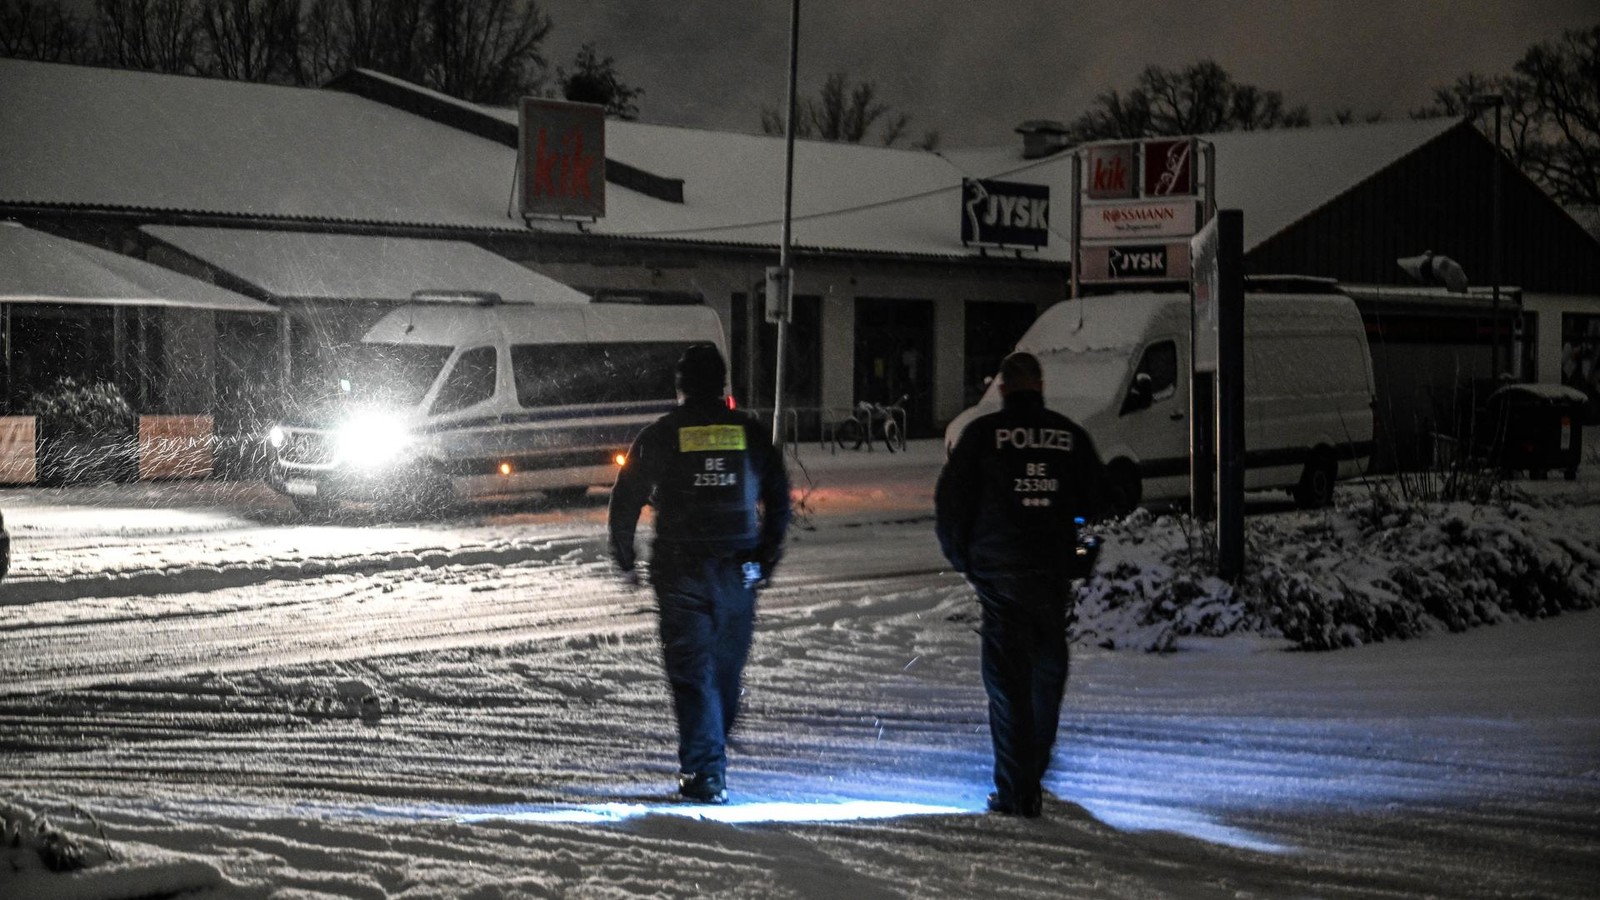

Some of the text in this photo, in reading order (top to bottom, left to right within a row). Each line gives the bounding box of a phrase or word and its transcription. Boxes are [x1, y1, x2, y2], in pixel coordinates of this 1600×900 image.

[533, 123, 595, 199] kik
[1094, 156, 1125, 190] kik
[982, 193, 1048, 229] JYSK
[1103, 207, 1174, 222] ROSSMANN
[1121, 252, 1165, 271] JYSK
[704, 457, 727, 471] BE
[1026, 463, 1048, 476] BE
[693, 472, 738, 487] 25314
